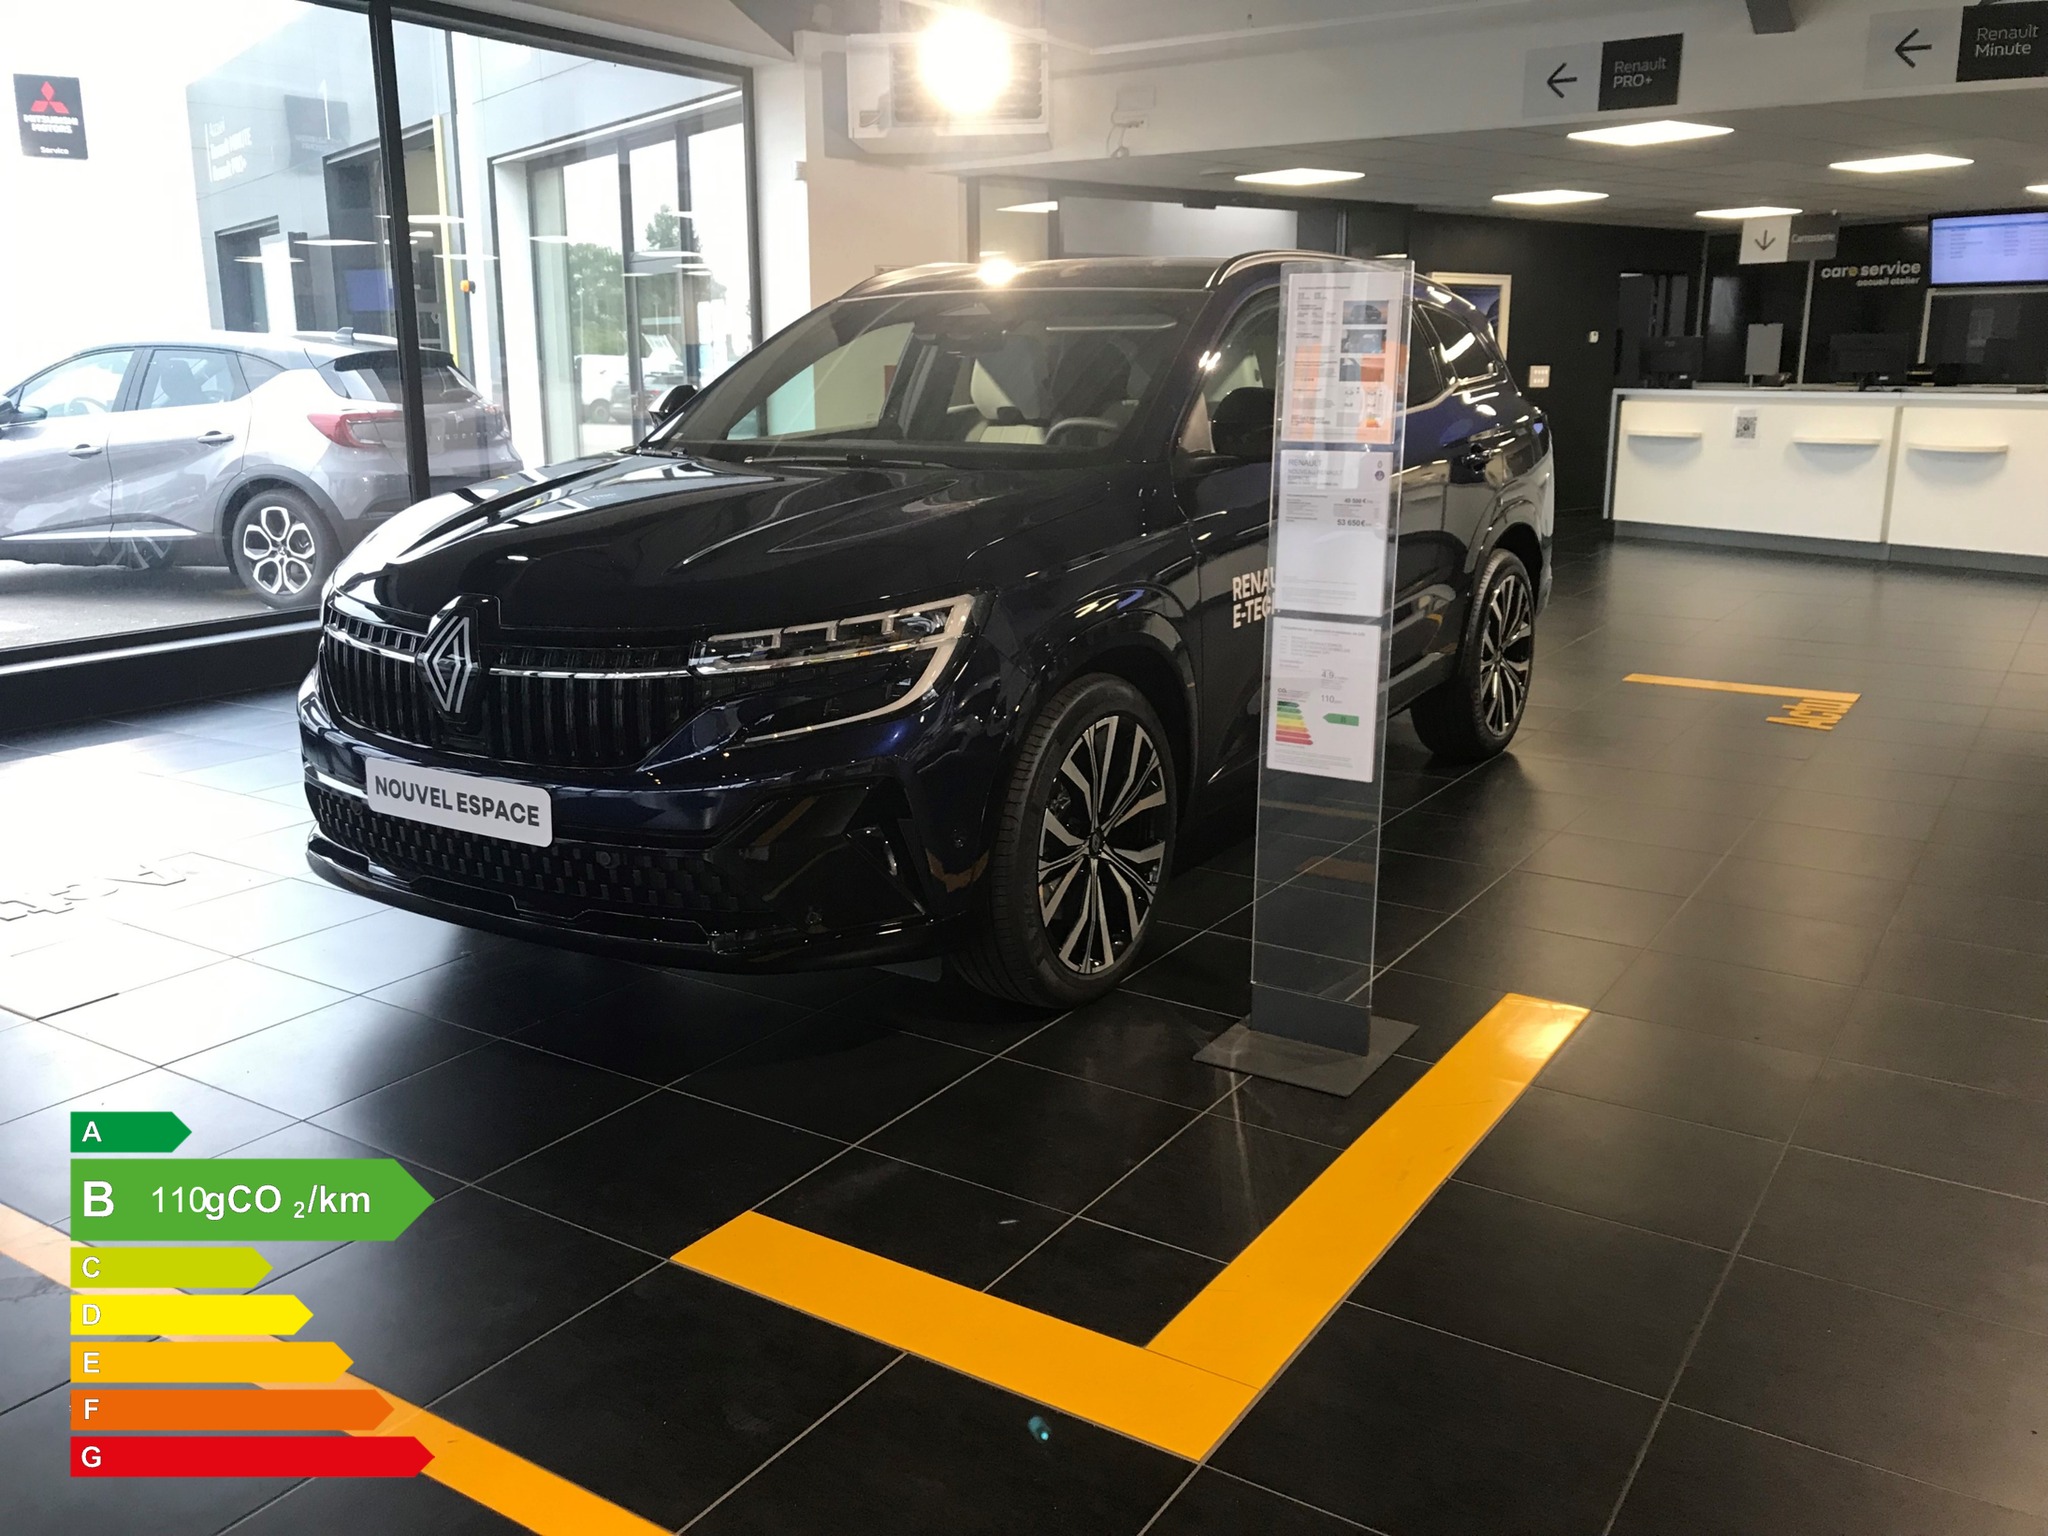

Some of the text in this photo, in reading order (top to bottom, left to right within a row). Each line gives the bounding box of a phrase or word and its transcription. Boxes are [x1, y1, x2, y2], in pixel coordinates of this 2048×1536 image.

[1976, 24, 2039, 41] Renault
[1975, 42, 2032, 58] Minute
[1614, 56, 1667, 74] Renault
[1613, 74, 1653, 89] PRO+
[40, 146, 70, 155] Service
[1821, 260, 1921, 279] care service
[1321, 694, 1335, 704] 110
[374, 775, 541, 828] NOUVEL ESPACE
